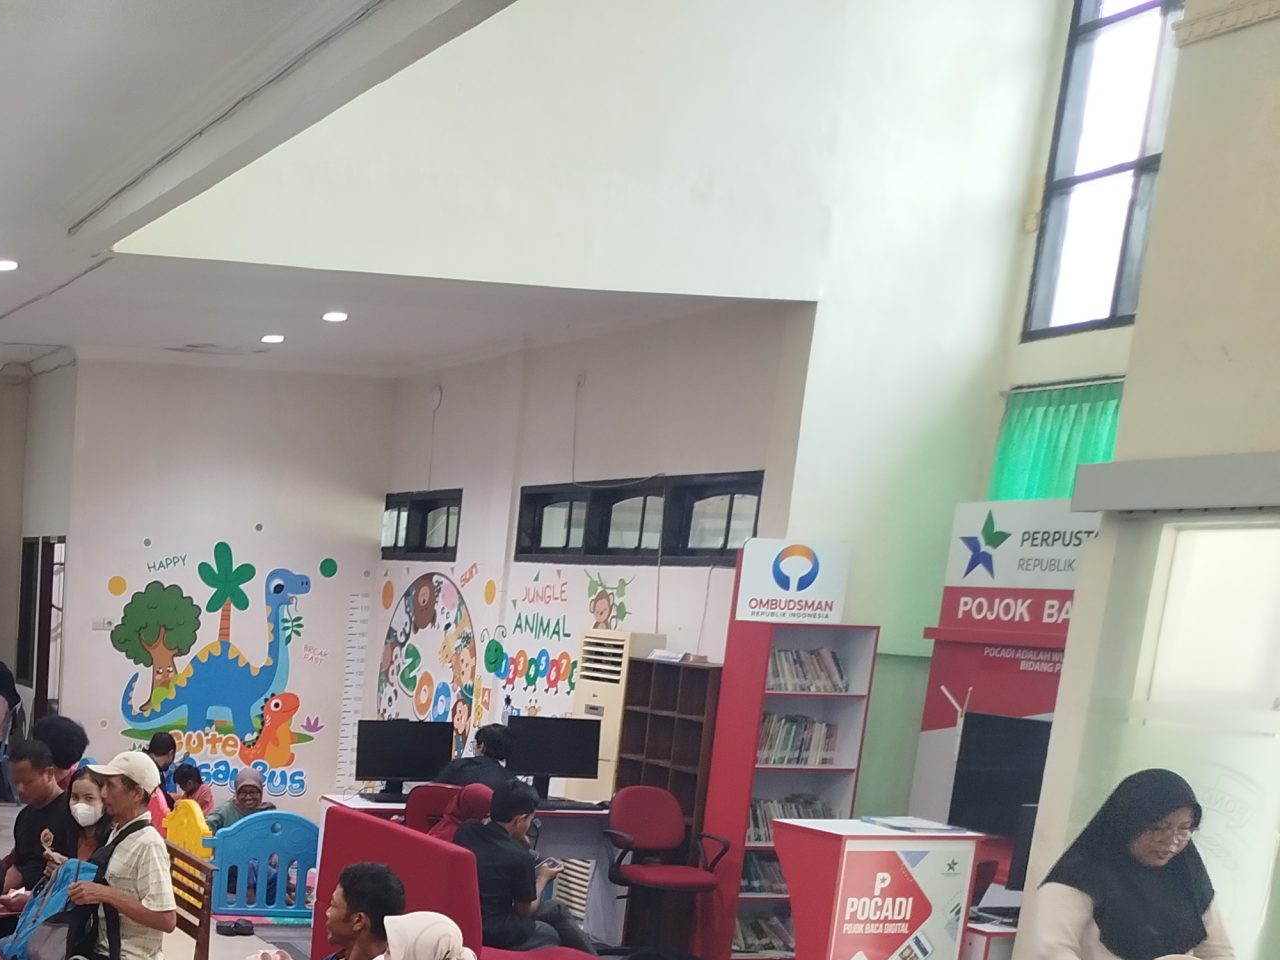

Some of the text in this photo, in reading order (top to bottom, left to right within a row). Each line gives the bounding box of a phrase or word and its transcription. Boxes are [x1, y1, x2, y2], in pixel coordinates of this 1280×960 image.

[146, 554, 187, 573] HAPPY
[1017, 558, 1076, 572] REPUBLIK
[522, 582, 568, 604] JUNGLE
[748, 597, 834, 612] OMBUDSMAN
[957, 597, 1033, 622] POJOK
[750, 610, 829, 619] REPUBLIK INDONESIA
[513, 612, 571, 642] ANIMAL
[983, 647, 1015, 658] POCADI
[1015, 649, 1051, 661] ADALAH
[1020, 660, 1054, 673] BIDANG
[845, 897, 913, 920] POCADI
[865, 923, 883, 934] BACA
[884, 923, 909, 934] DIGITAL
